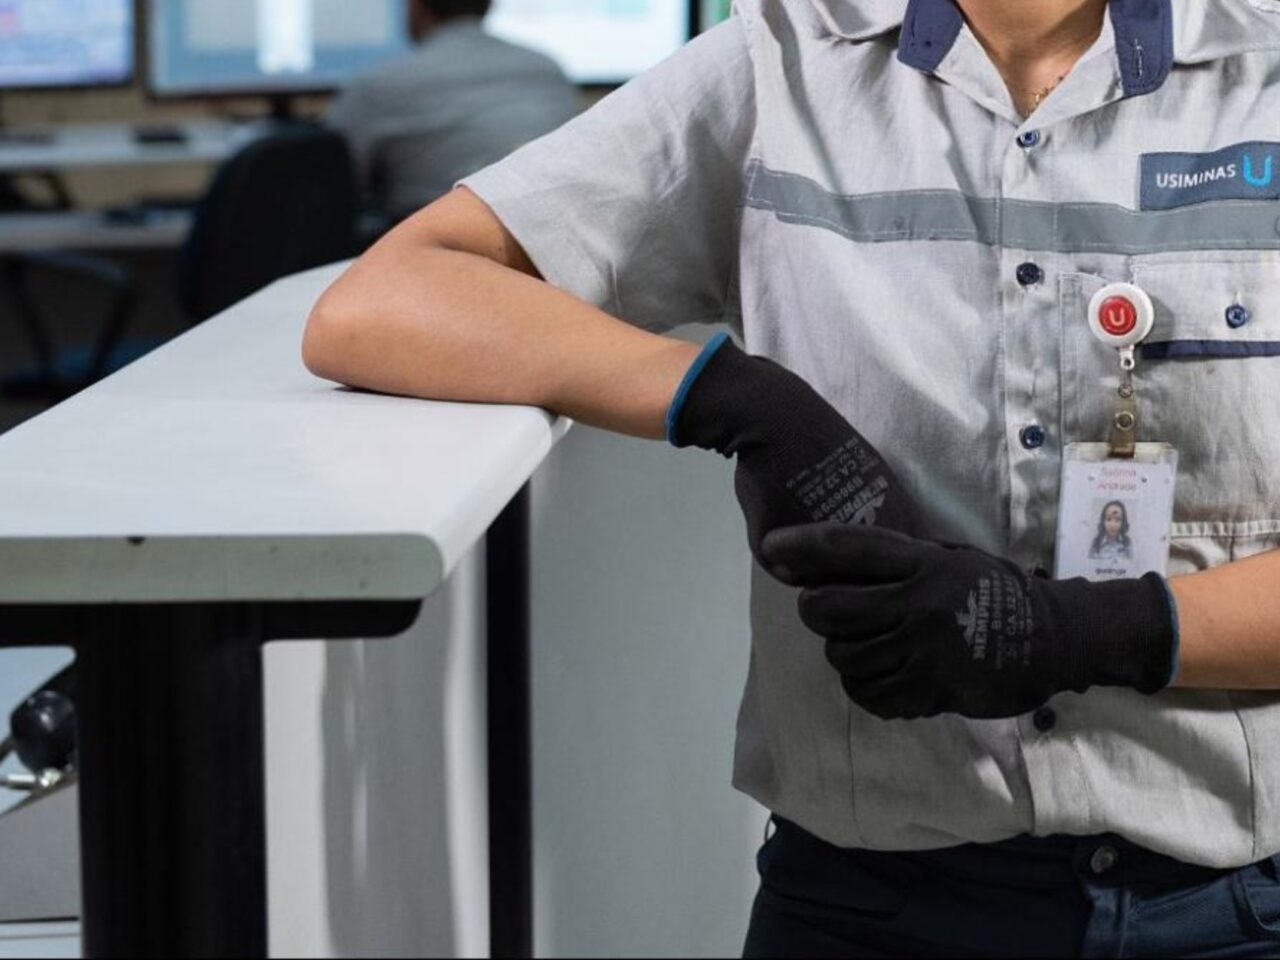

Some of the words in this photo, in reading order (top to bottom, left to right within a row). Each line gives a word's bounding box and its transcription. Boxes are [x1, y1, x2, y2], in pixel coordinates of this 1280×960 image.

[1156, 164, 1236, 189] USIMINAS
[1243, 152, 1272, 187] U
[1108, 306, 1126, 327] U
[973, 578, 990, 660] MEMPHIS
